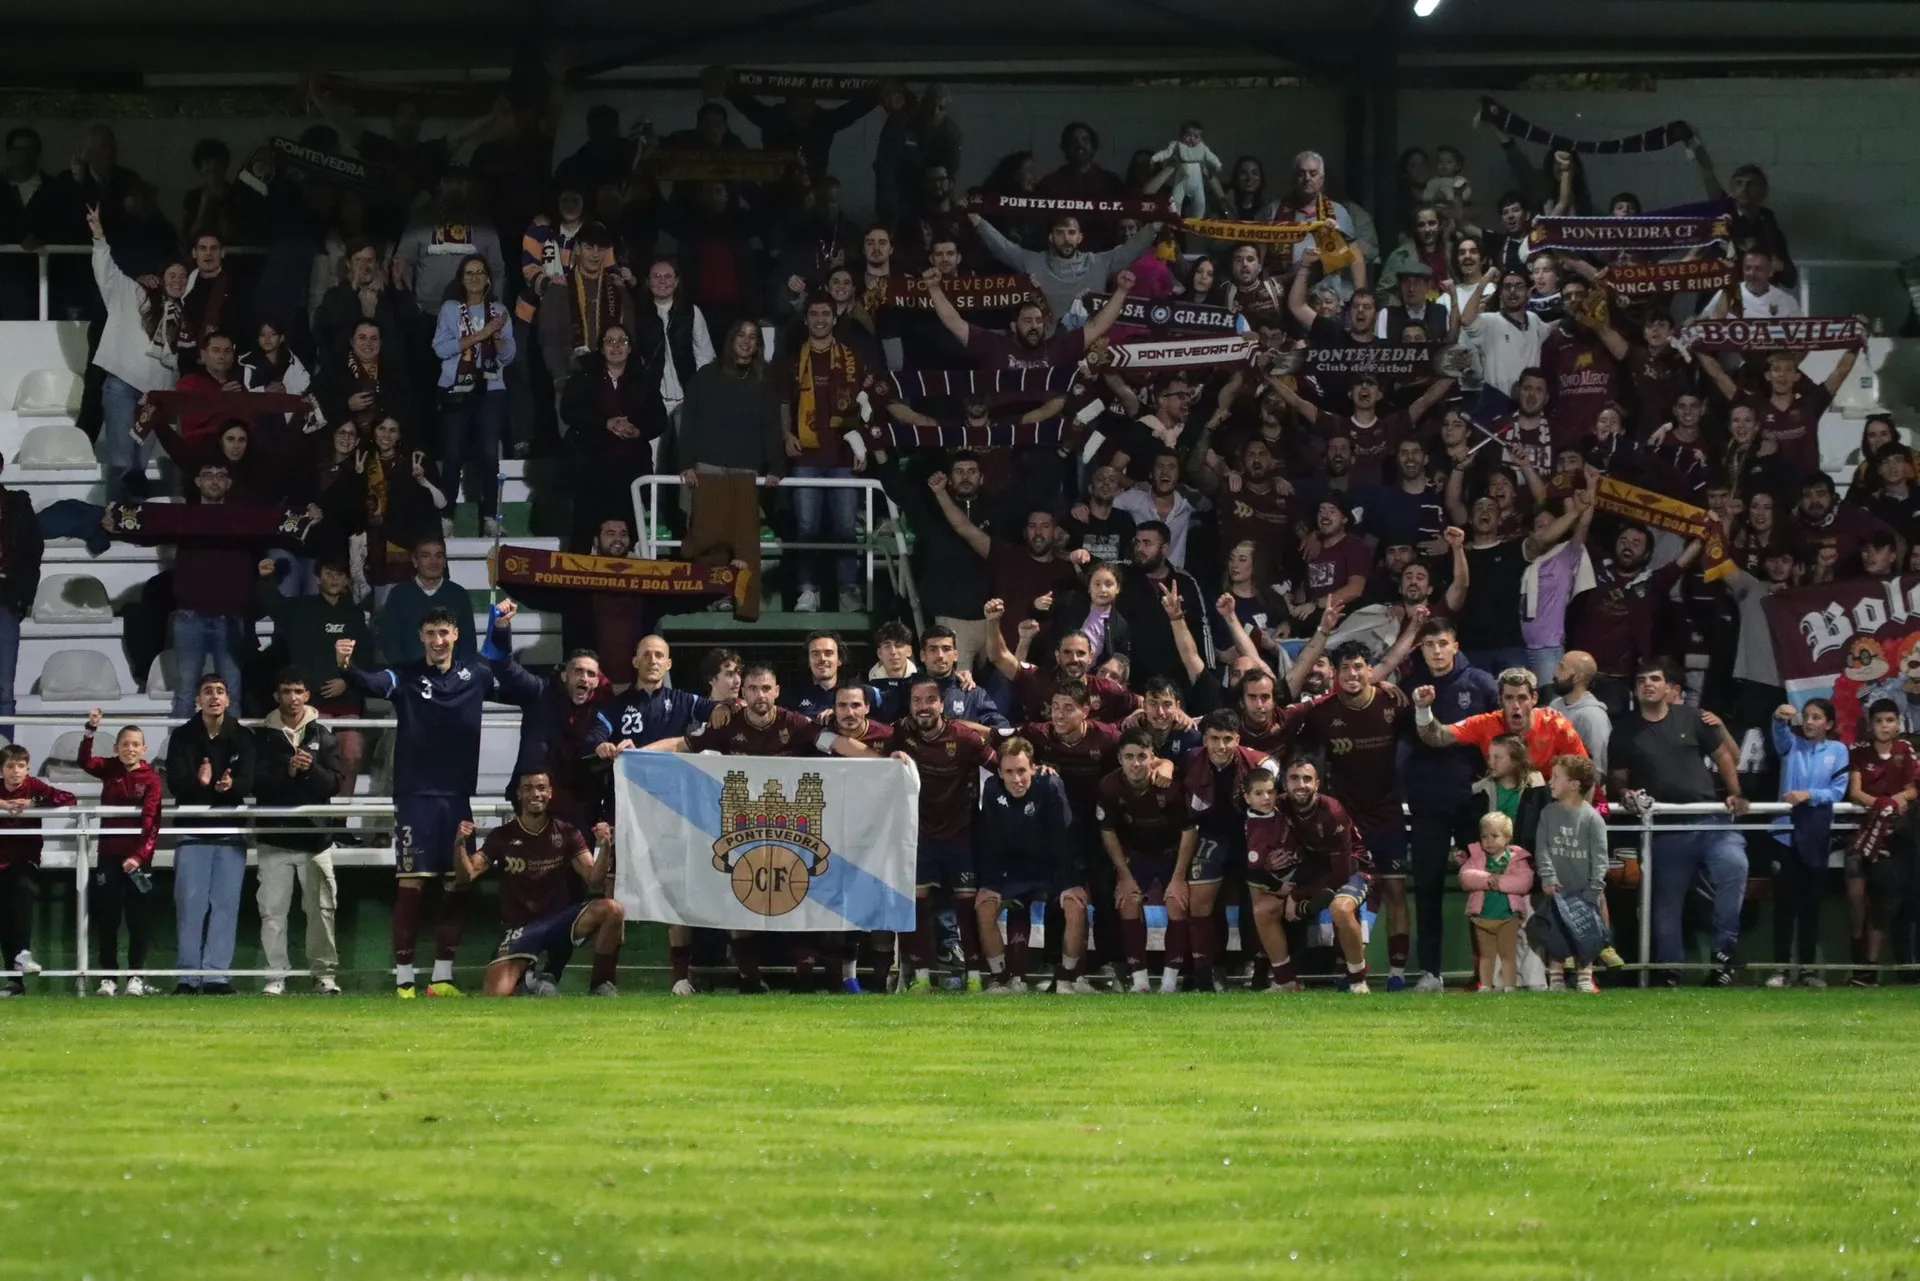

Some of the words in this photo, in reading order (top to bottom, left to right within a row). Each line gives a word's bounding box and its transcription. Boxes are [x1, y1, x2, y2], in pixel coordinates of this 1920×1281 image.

[275, 138, 365, 178] PONTEVEDRA
[999, 195, 1094, 210] PONTEVEDRA
[1099, 201, 1124, 211] C.F.
[1561, 225, 1671, 239] PONTEVEDRA
[1675, 224, 1697, 238] CF
[1613, 261, 1720, 279] PONTEVEDRA
[907, 276, 1017, 291] POTEVEDRA
[1663, 279, 1681, 291] SE
[1687, 273, 1732, 290] RINDE
[895, 295, 938, 309] NUNC
[956, 295, 975, 308] SE
[983, 291, 1030, 308] RINDE
[1092, 297, 1145, 318] FSA
[1174, 309, 1235, 328] GRANA
[1701, 320, 1775, 345] BOA
[1779, 319, 1859, 344] VILA
[1138, 345, 1228, 360] PONTEVEDRA
[1230, 342, 1249, 354] CF
[1306, 347, 1429, 362] PONTEVEDRA
[1316, 363, 1348, 373] Club
[534, 571, 627, 589] PONTEVEDRA
[641, 578, 669, 590] BOA
[673, 579, 704, 591] VILA
[421, 678, 433, 699] 3
[621, 711, 644, 735] 23
[401, 825, 413, 847] 3
[726, 828, 820, 852] PONTEVEDRA
[1197, 836, 1218, 859] 17
[755, 866, 788, 892] CF
